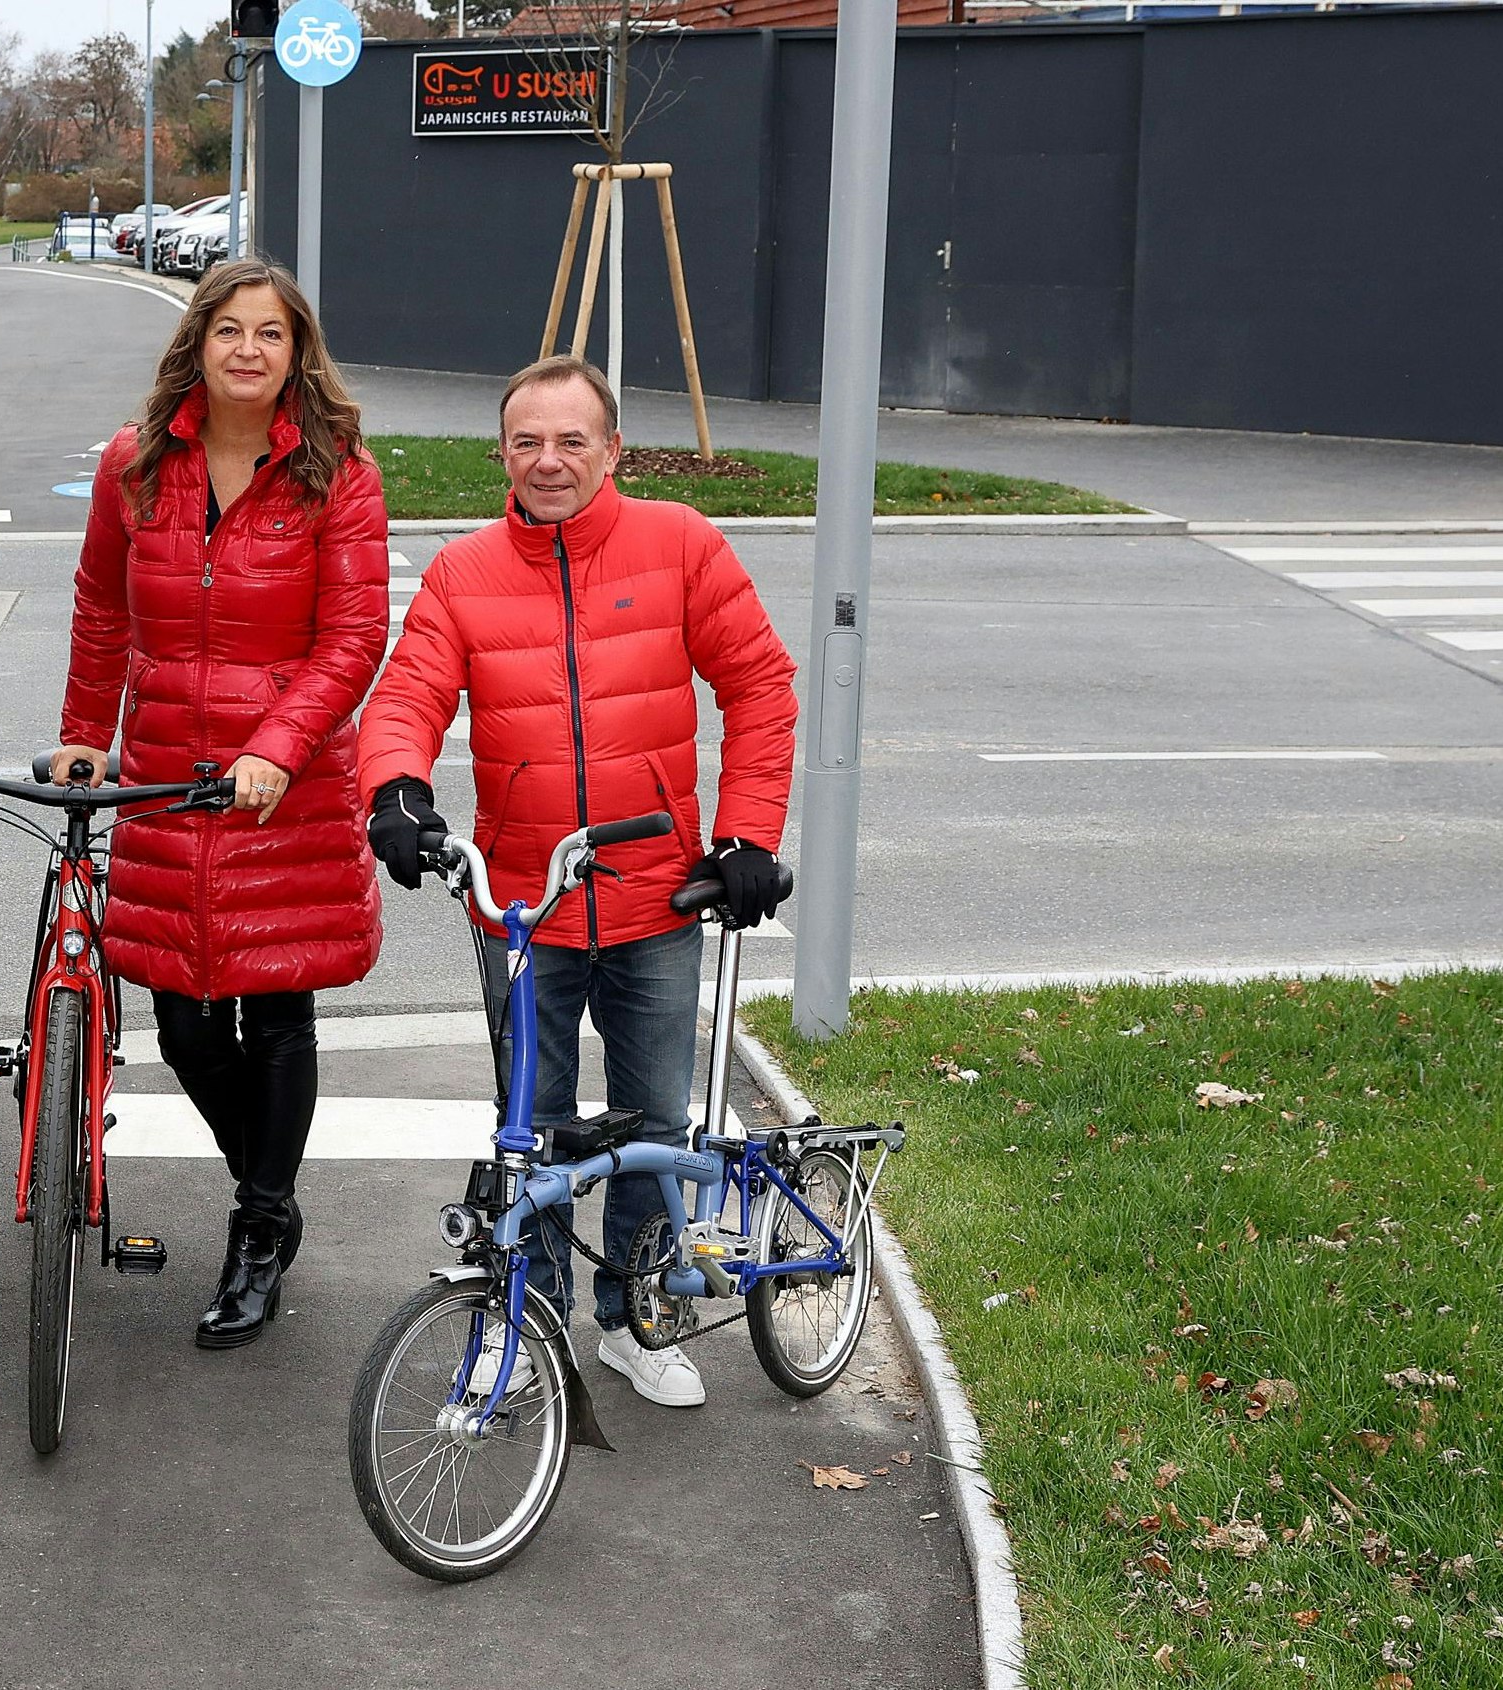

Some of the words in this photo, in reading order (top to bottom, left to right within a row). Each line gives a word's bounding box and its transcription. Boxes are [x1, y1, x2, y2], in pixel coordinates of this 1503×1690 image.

[492, 73, 511, 99] U
[517, 71, 597, 98] SUSHI
[420, 111, 507, 125] JAPANISCHES
[511, 110, 589, 124] RESTAURAN
